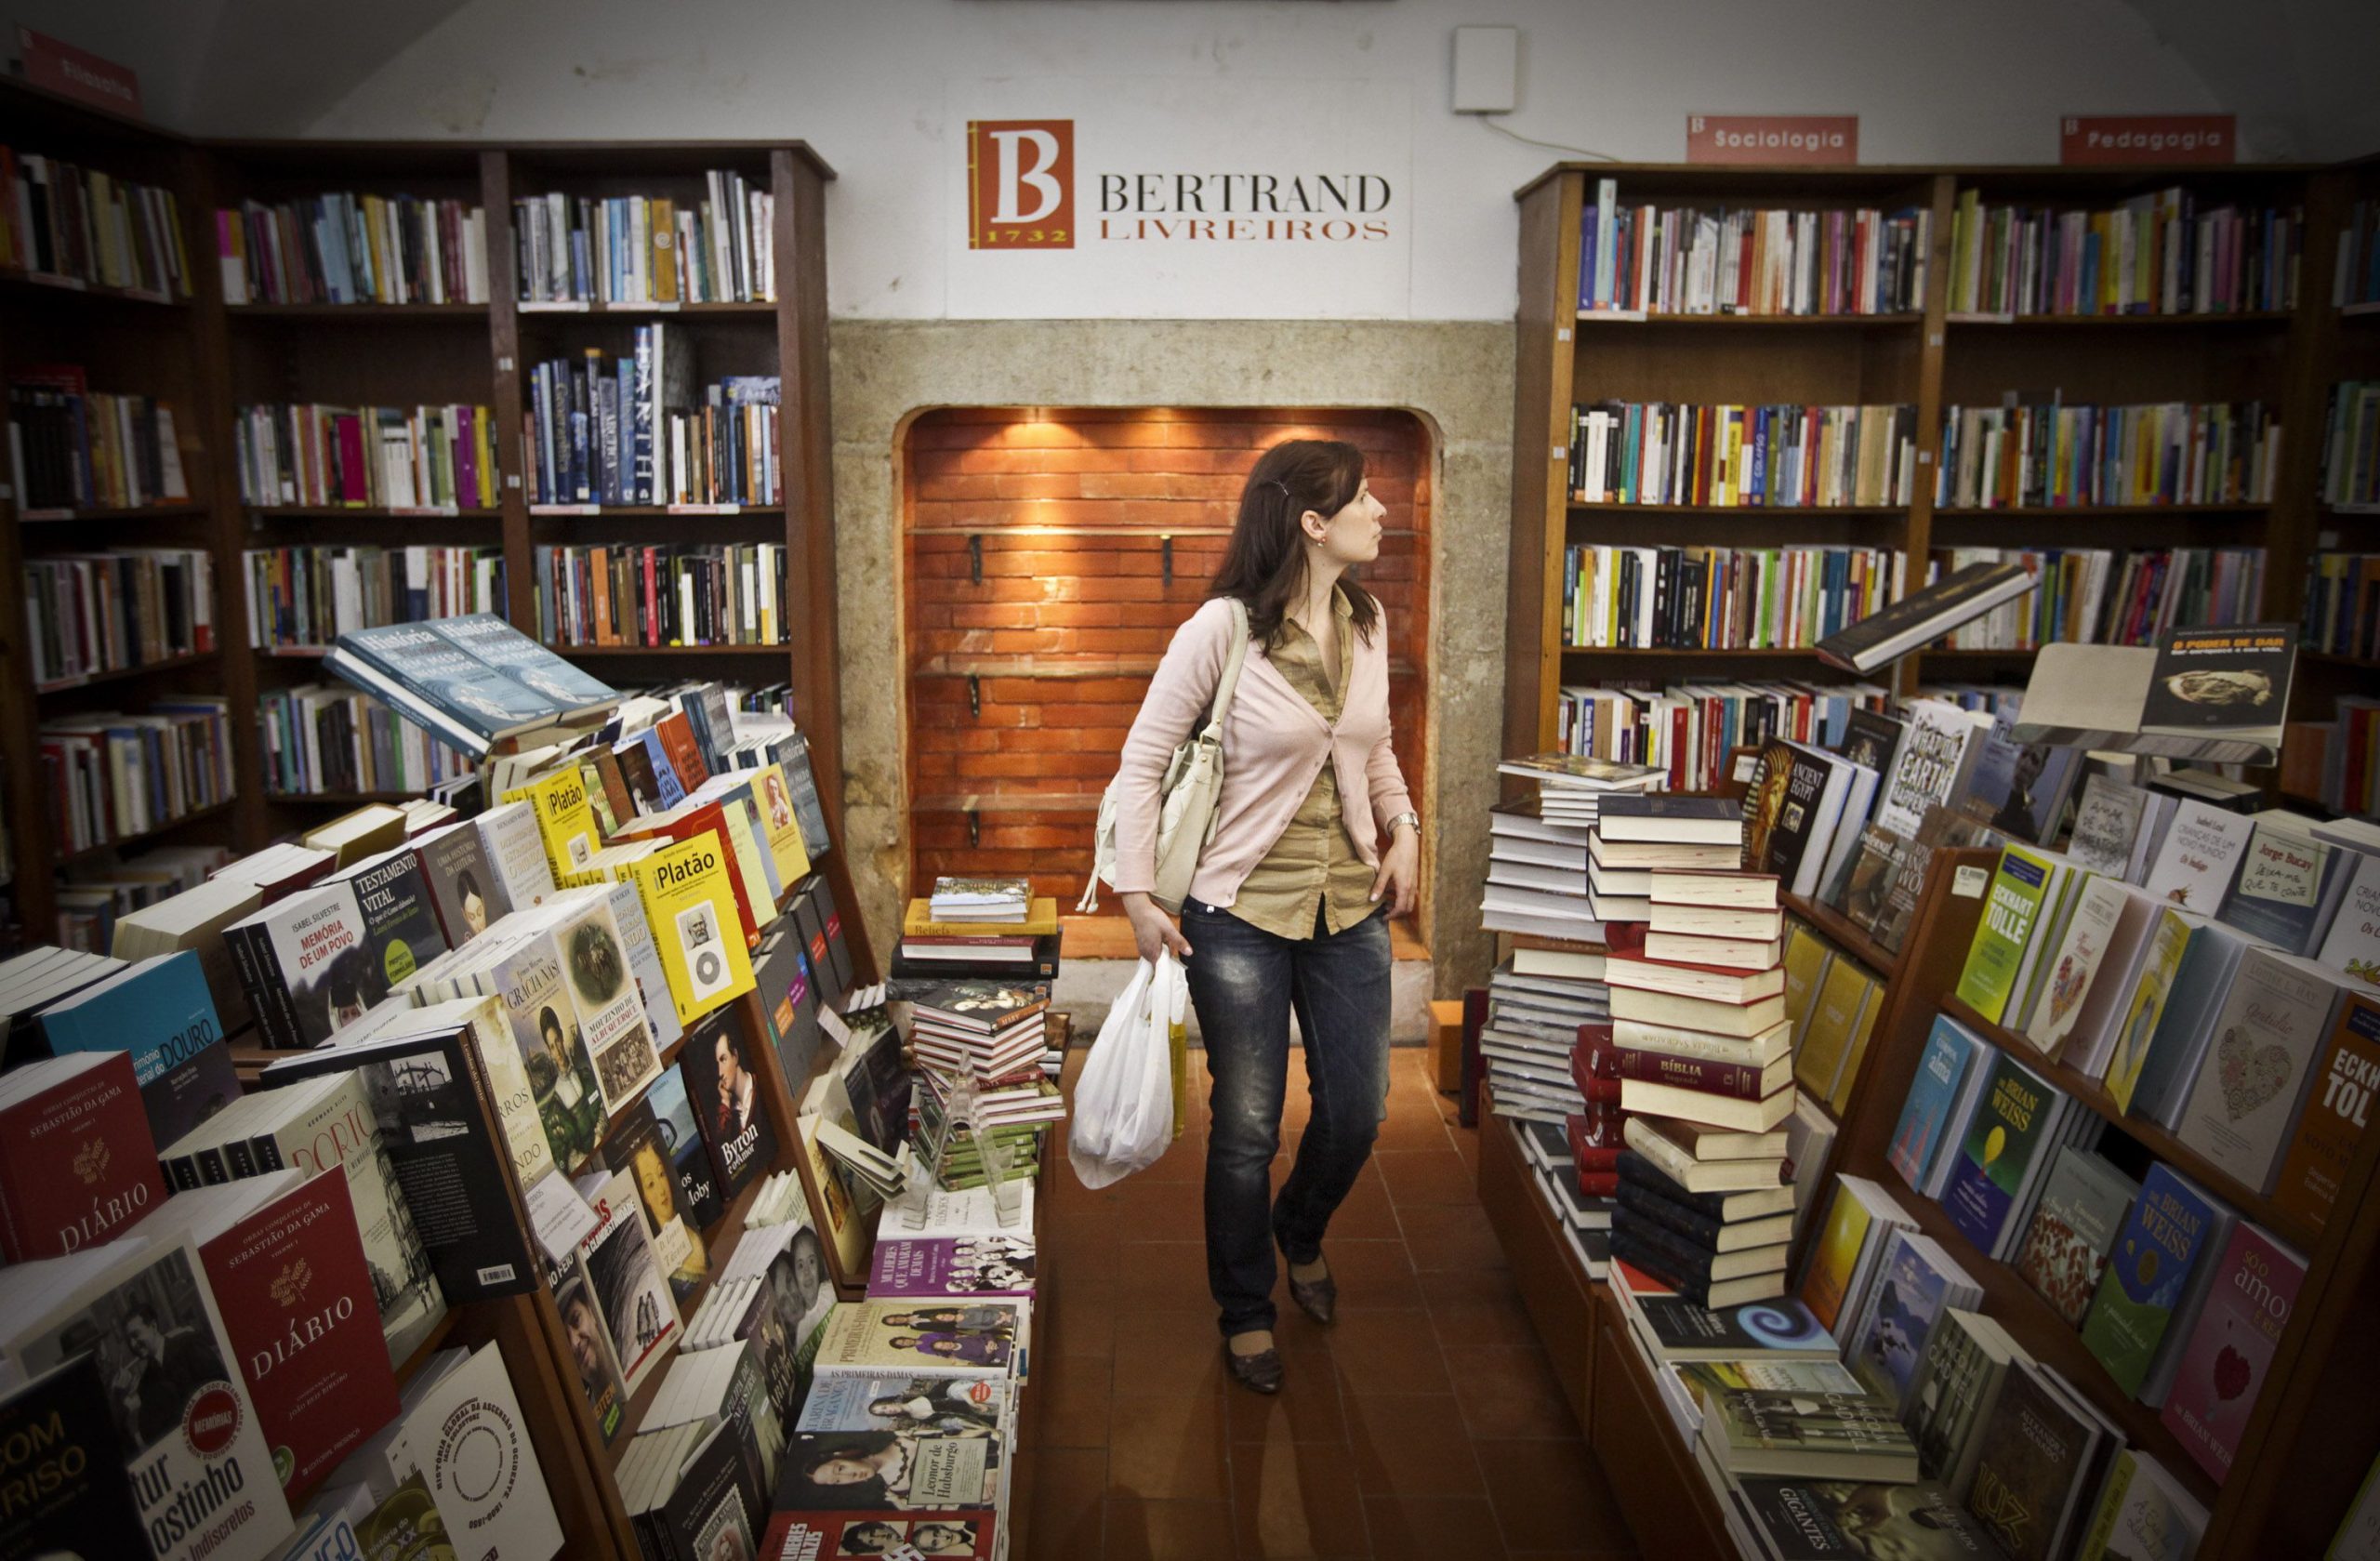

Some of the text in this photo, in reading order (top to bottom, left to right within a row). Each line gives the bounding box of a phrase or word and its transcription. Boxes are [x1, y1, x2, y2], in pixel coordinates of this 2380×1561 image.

[1714, 129, 1844, 151] Sociologia
[2087, 130, 2222, 152] Pedagogia
[990, 130, 1062, 223] B
[1097, 174, 1392, 213] BERTRAND
[986, 231, 1068, 243] 1732
[1100, 219, 1391, 241] LIVREIROS
[360, 628, 438, 651] História
[438, 619, 508, 640] História
[1791, 779, 1815, 802] EGYPT
[1792, 761, 1824, 786] ANCIENT
[355, 853, 417, 893] TESTAMENTO
[2258, 843, 2313, 873] Jorge Bucay
[363, 887, 396, 914] VITAL
[1993, 884, 2033, 918] ECKHART
[2244, 879, 2265, 892] QUE
[292, 902, 341, 933] ISABEL SILVESTRE
[300, 920, 344, 951] MEMÓRIA
[1986, 903, 2028, 946] TOLLE
[299, 930, 354, 970] DE UM POVO
[588, 996, 634, 1034] MOUZINHO DE
[590, 1005, 638, 1046] ALBUQUERQUE
[159, 1018, 214, 1068] DOURO
[1660, 1058, 1702, 1077] BÍBLIA
[1664, 1074, 1699, 1085] Sagrada
[2332, 1047, 2380, 1091] ECKH
[29, 1085, 123, 1139] SEBASTIÃO DA GAMA
[1992, 1089, 2031, 1132] WEISS
[2006, 1078, 2039, 1113] BRIAN
[2322, 1071, 2369, 1130] TOL
[292, 1101, 372, 1178] PORTO
[721, 1123, 759, 1166] Byron
[736, 1144, 754, 1164] Amor
[60, 1183, 149, 1255] DIÁRIO
[243, 1229, 264, 1245] OBRAS
[265, 1207, 304, 1232] COMPLETAS
[2141, 1204, 2191, 1262] WEISS
[2160, 1193, 2202, 1237] BRIAN
[229, 1202, 331, 1269] SEBASTIÃO DA GAMA
[2258, 1264, 2269, 1278] O
[250, 1296, 353, 1382] DIÁRIO
[841, 1369, 885, 1380] PRIMEIRAS
[193, 1409, 234, 1435] MEMÓRIAS
[444, 1408, 471, 1438] GLOBAL
[470, 1401, 482, 1412] DA
[482, 1401, 513, 1432] ASCENSÃO
[0, 1410, 65, 1475] OM
[443, 1412, 481, 1463] JACK GOLDSTONE
[509, 1430, 517, 1447] DO
[2021, 1410, 2067, 1459] ALEXANDRA
[2182, 1410, 2233, 1469] BRIAN WEIS
[3, 1446, 86, 1516] RISO
[130, 1452, 174, 1513] tur
[436, 1436, 448, 1490] HISTÓRIA
[502, 1447, 520, 1500] OCIDENTE
[921, 1443, 943, 1499] Leonor de
[936, 1442, 958, 1500] Habsburgo
[151, 1456, 245, 1555] ostinho
[1779, 1488, 1831, 1550] GIGANTES
[189, 1500, 256, 1561] Indiscretos
[779, 1523, 809, 1561] LHERES
